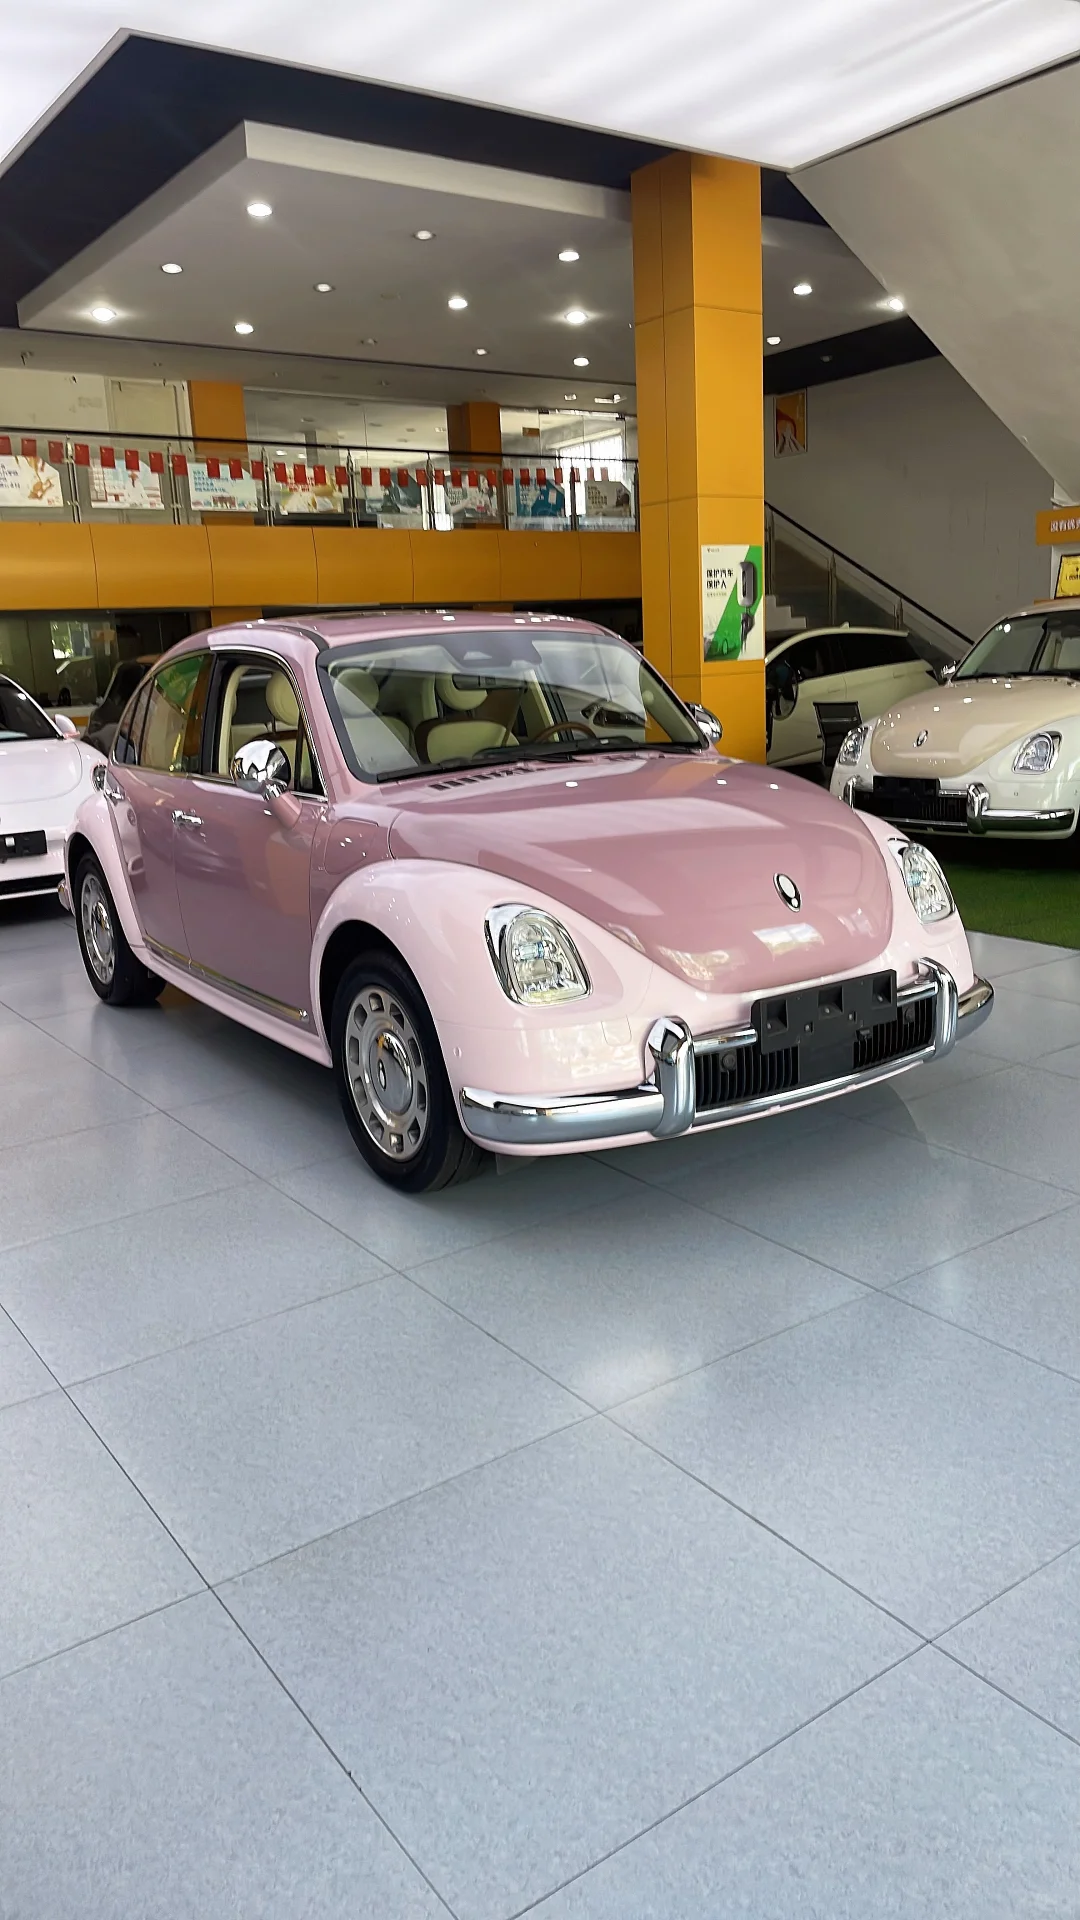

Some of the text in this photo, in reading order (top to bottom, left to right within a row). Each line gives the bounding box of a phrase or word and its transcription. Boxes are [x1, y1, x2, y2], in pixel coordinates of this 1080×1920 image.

[706, 568, 734, 578] 保护汽车
[706, 579, 727, 589] 保护人
